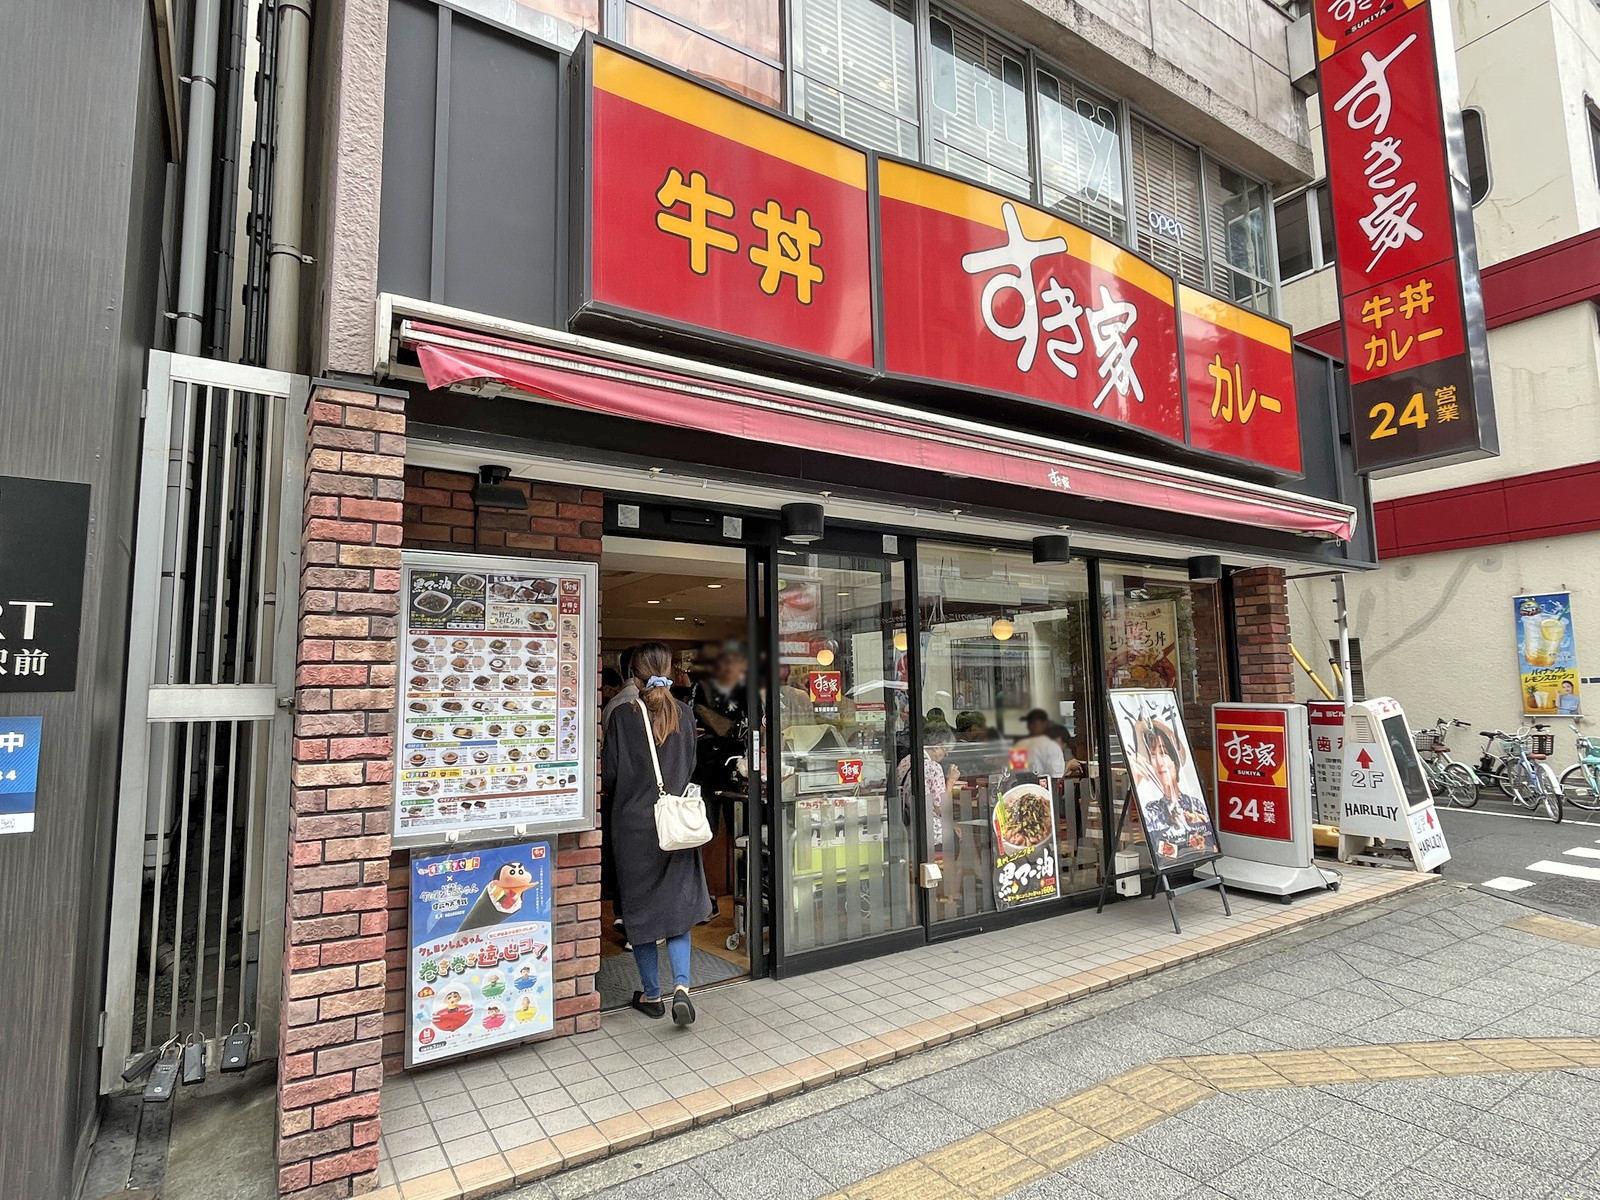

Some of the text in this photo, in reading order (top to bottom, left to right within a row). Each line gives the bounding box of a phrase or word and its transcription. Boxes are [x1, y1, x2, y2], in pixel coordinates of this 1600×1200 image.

[1351, 8, 1387, 33] SUKIYA
[1333, 33, 1424, 274] すき家
[655, 166, 824, 305] 牛丼
[1148, 211, 1184, 239] open
[962, 201, 1144, 410] すき家
[1361, 278, 1435, 329] 牛丼
[1364, 328, 1444, 371] カレー
[1208, 353, 1282, 424] カレー
[1368, 384, 1460, 440] 24 営業
[0, 601, 54, 640] T
[813, 674, 838, 693] すき家
[1531, 666, 1566, 676] パイナップル
[1224, 731, 1276, 770] すき家
[1237, 769, 1261, 777] SUKIYA
[1351, 770, 1384, 789] 2F
[1229, 796, 1276, 824] 24 営業
[998, 848, 1053, 899] 黒マー油
[418, 935, 484, 957] クレヨンしんちゃん
